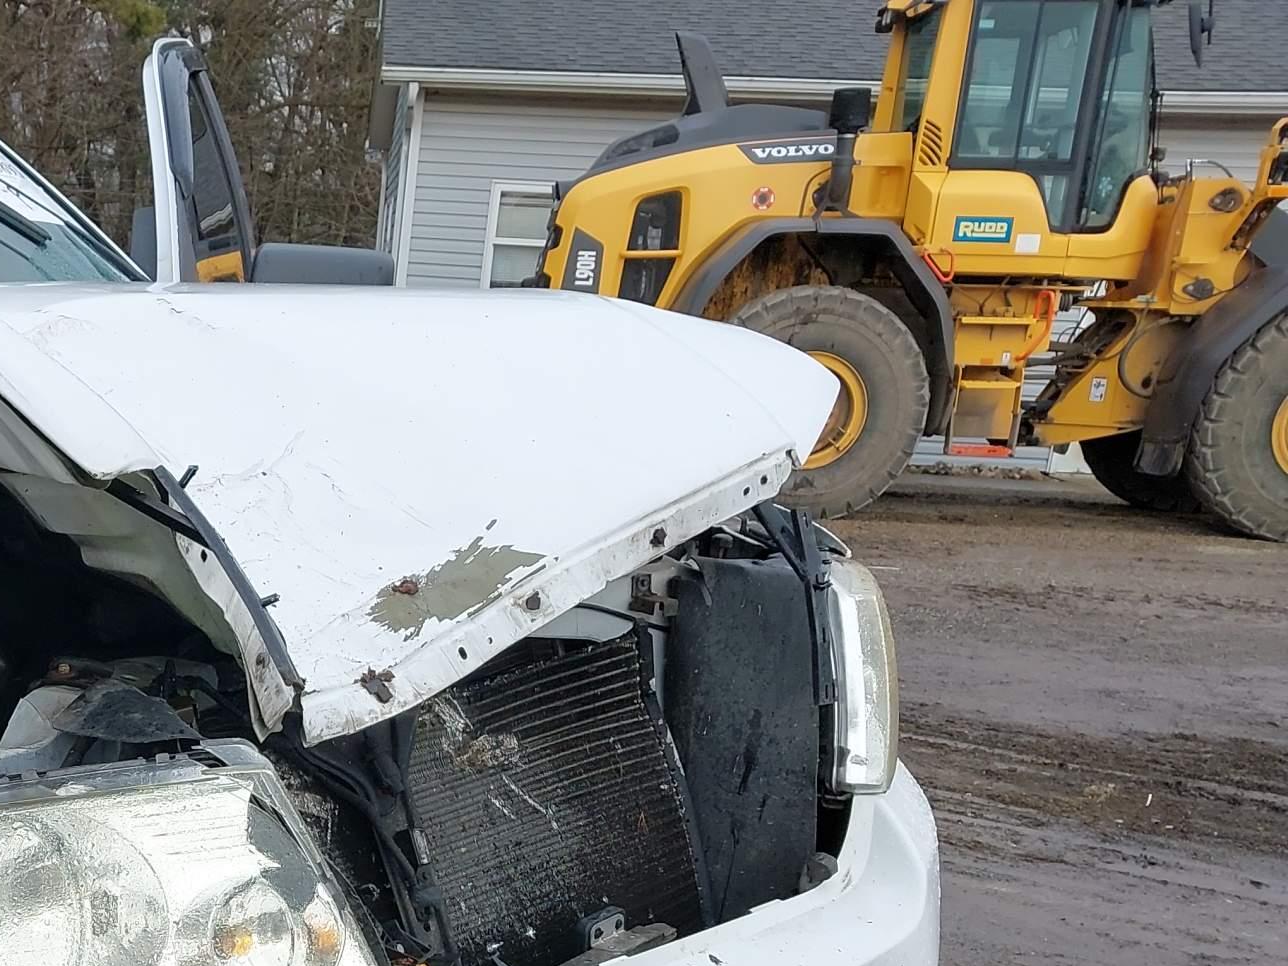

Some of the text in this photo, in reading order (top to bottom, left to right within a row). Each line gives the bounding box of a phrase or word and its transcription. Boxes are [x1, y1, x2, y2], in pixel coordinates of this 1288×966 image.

[752, 144, 834, 158] VOLVO
[958, 221, 1008, 237] RUDD
[574, 250, 597, 286] L90H
